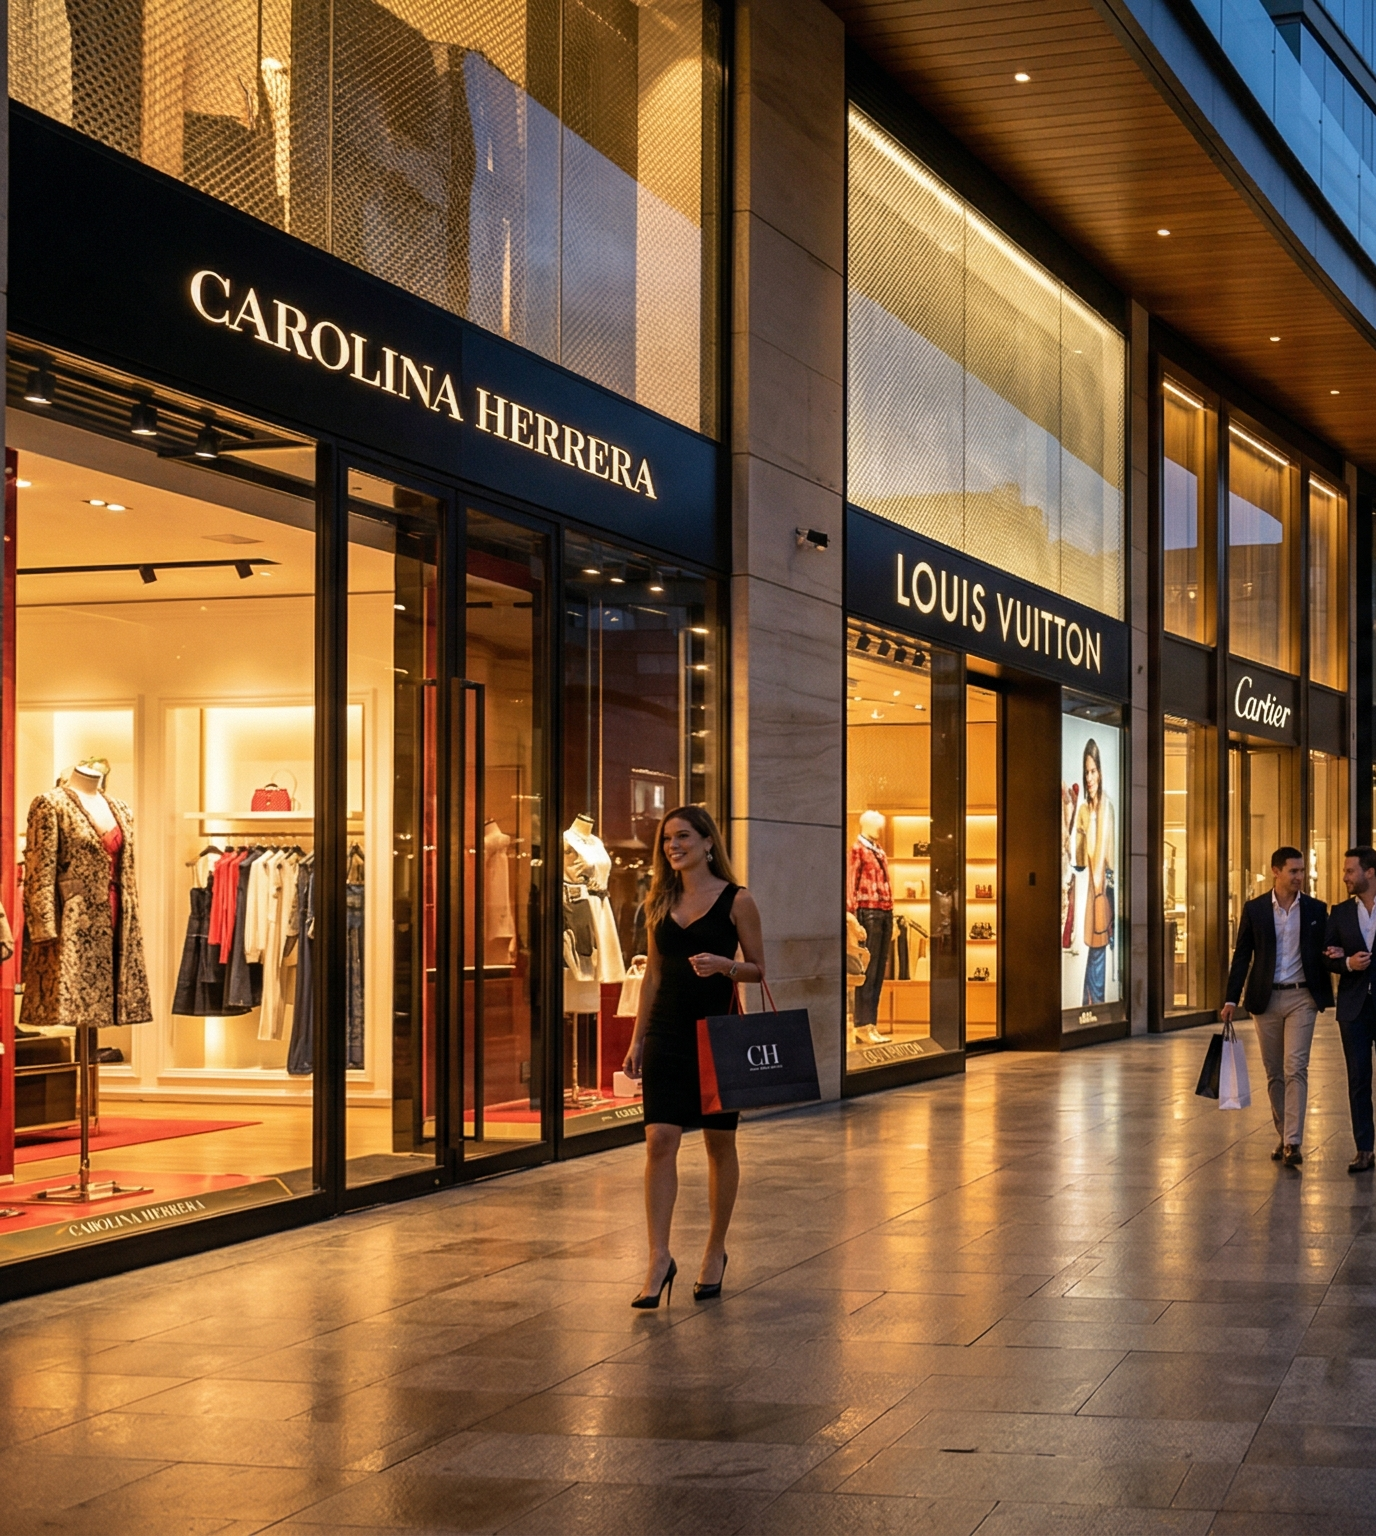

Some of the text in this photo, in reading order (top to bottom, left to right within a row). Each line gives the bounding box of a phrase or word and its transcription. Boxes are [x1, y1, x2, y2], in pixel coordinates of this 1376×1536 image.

[189, 269, 658, 500] CAROLINA HERRERA
[896, 552, 1101, 674] LOUIS VUITTON
[1234, 675, 1292, 728] Cartier
[747, 1043, 780, 1067] CH
